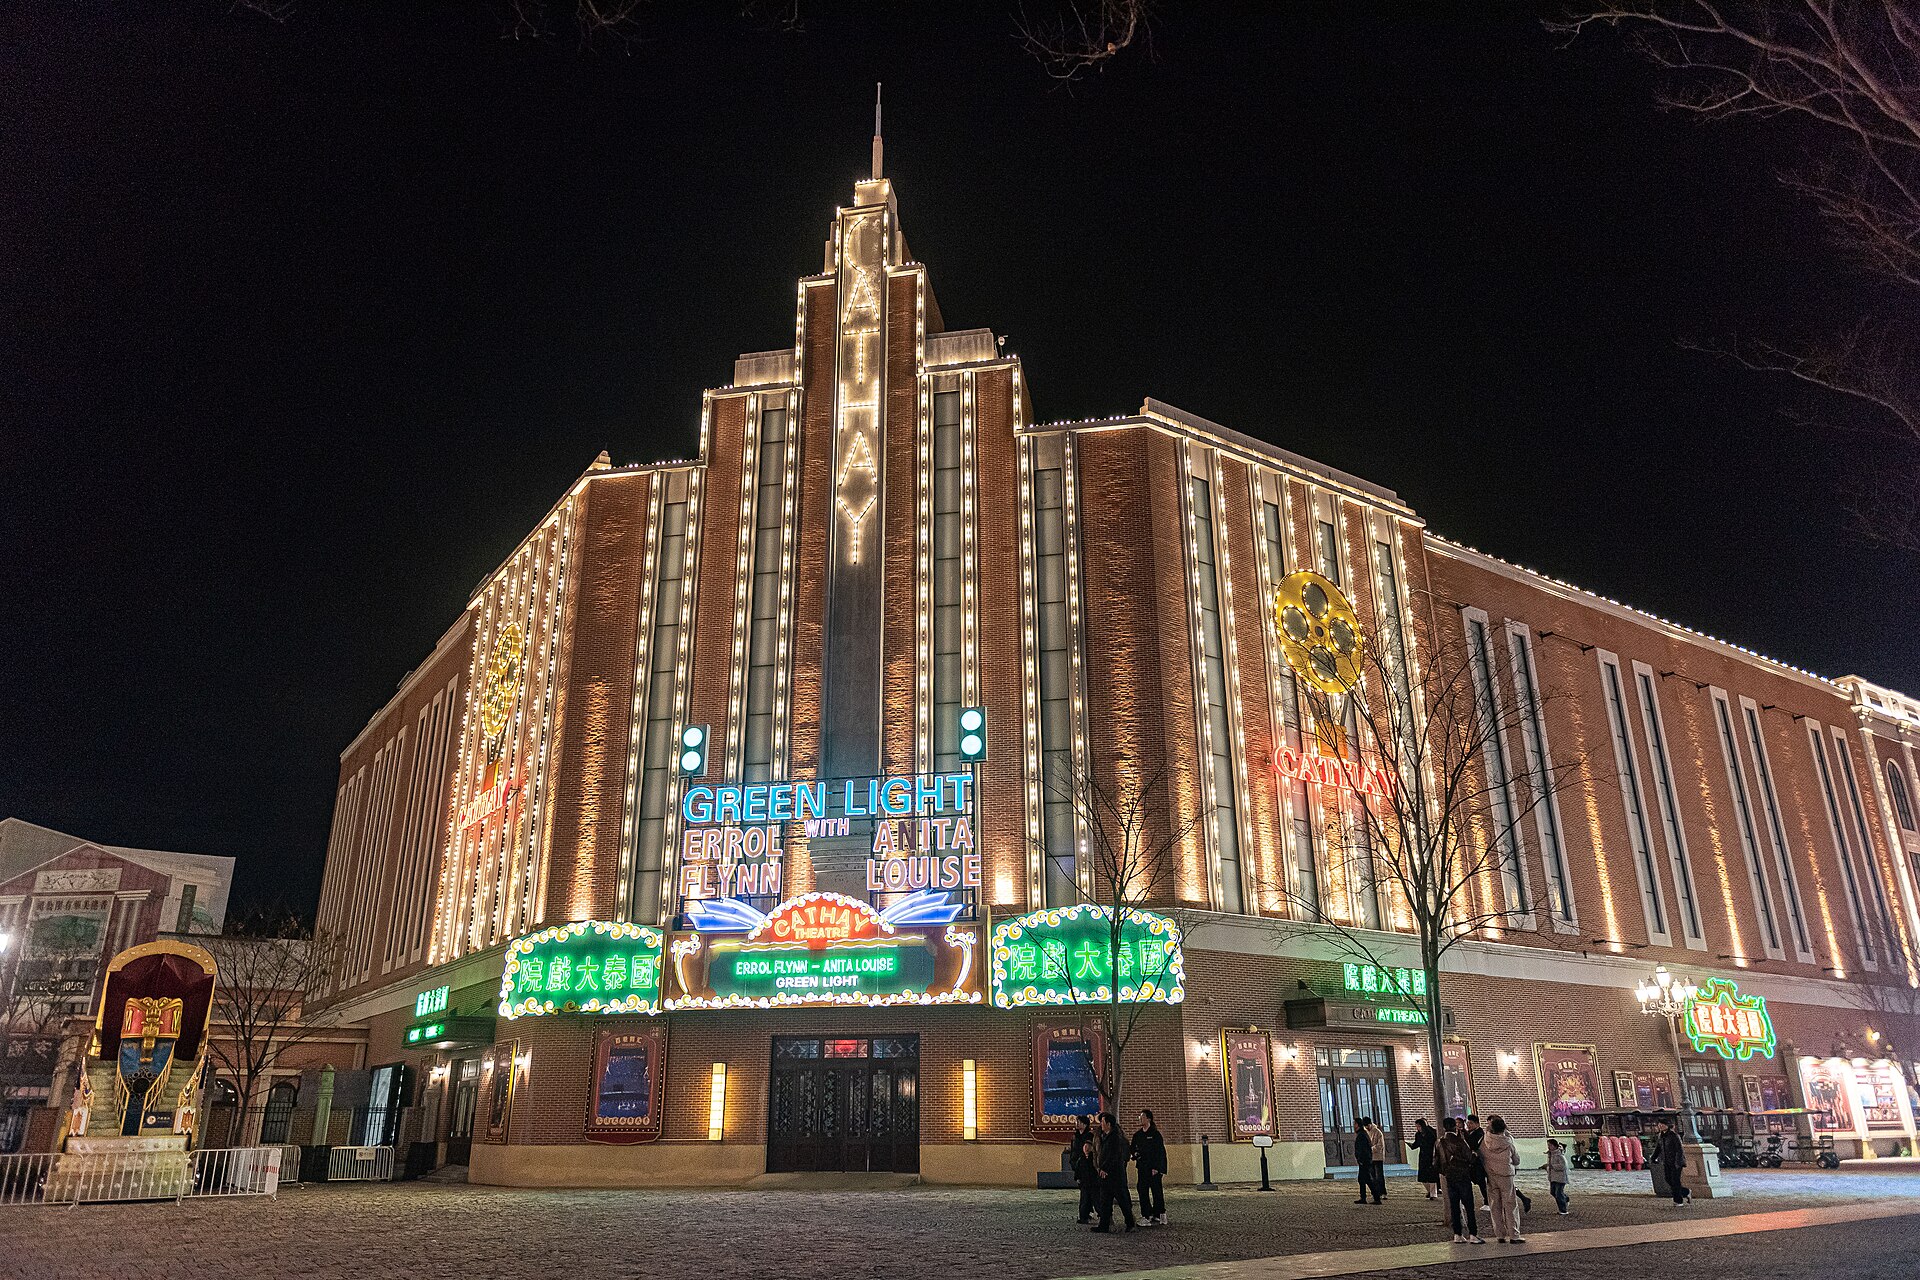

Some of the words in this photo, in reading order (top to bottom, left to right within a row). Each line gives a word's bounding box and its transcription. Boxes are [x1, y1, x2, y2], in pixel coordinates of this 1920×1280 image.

[837, 215, 880, 564] CATHAY
[1273, 746, 1397, 798] CATHAY
[683, 780, 827, 823] GREEN
[844, 774, 974, 816] LIGHT
[682, 825, 784, 860] ERROL
[804, 818, 850, 838] WITH
[873, 817, 975, 853] ANITA
[680, 863, 783, 896] FLYNN
[866, 854, 982, 891] LOUISE
[774, 906, 870, 937] CATHAY
[793, 927, 850, 939] THEATRE
[736, 961, 772, 975] ERROL
[774, 960, 808, 974] FLYNN
[823, 959, 854, 973] ANITA
[855, 957, 894, 972] LOUISE
[775, 976, 819, 989] GREEN
[822, 975, 859, 988] LIGHT
